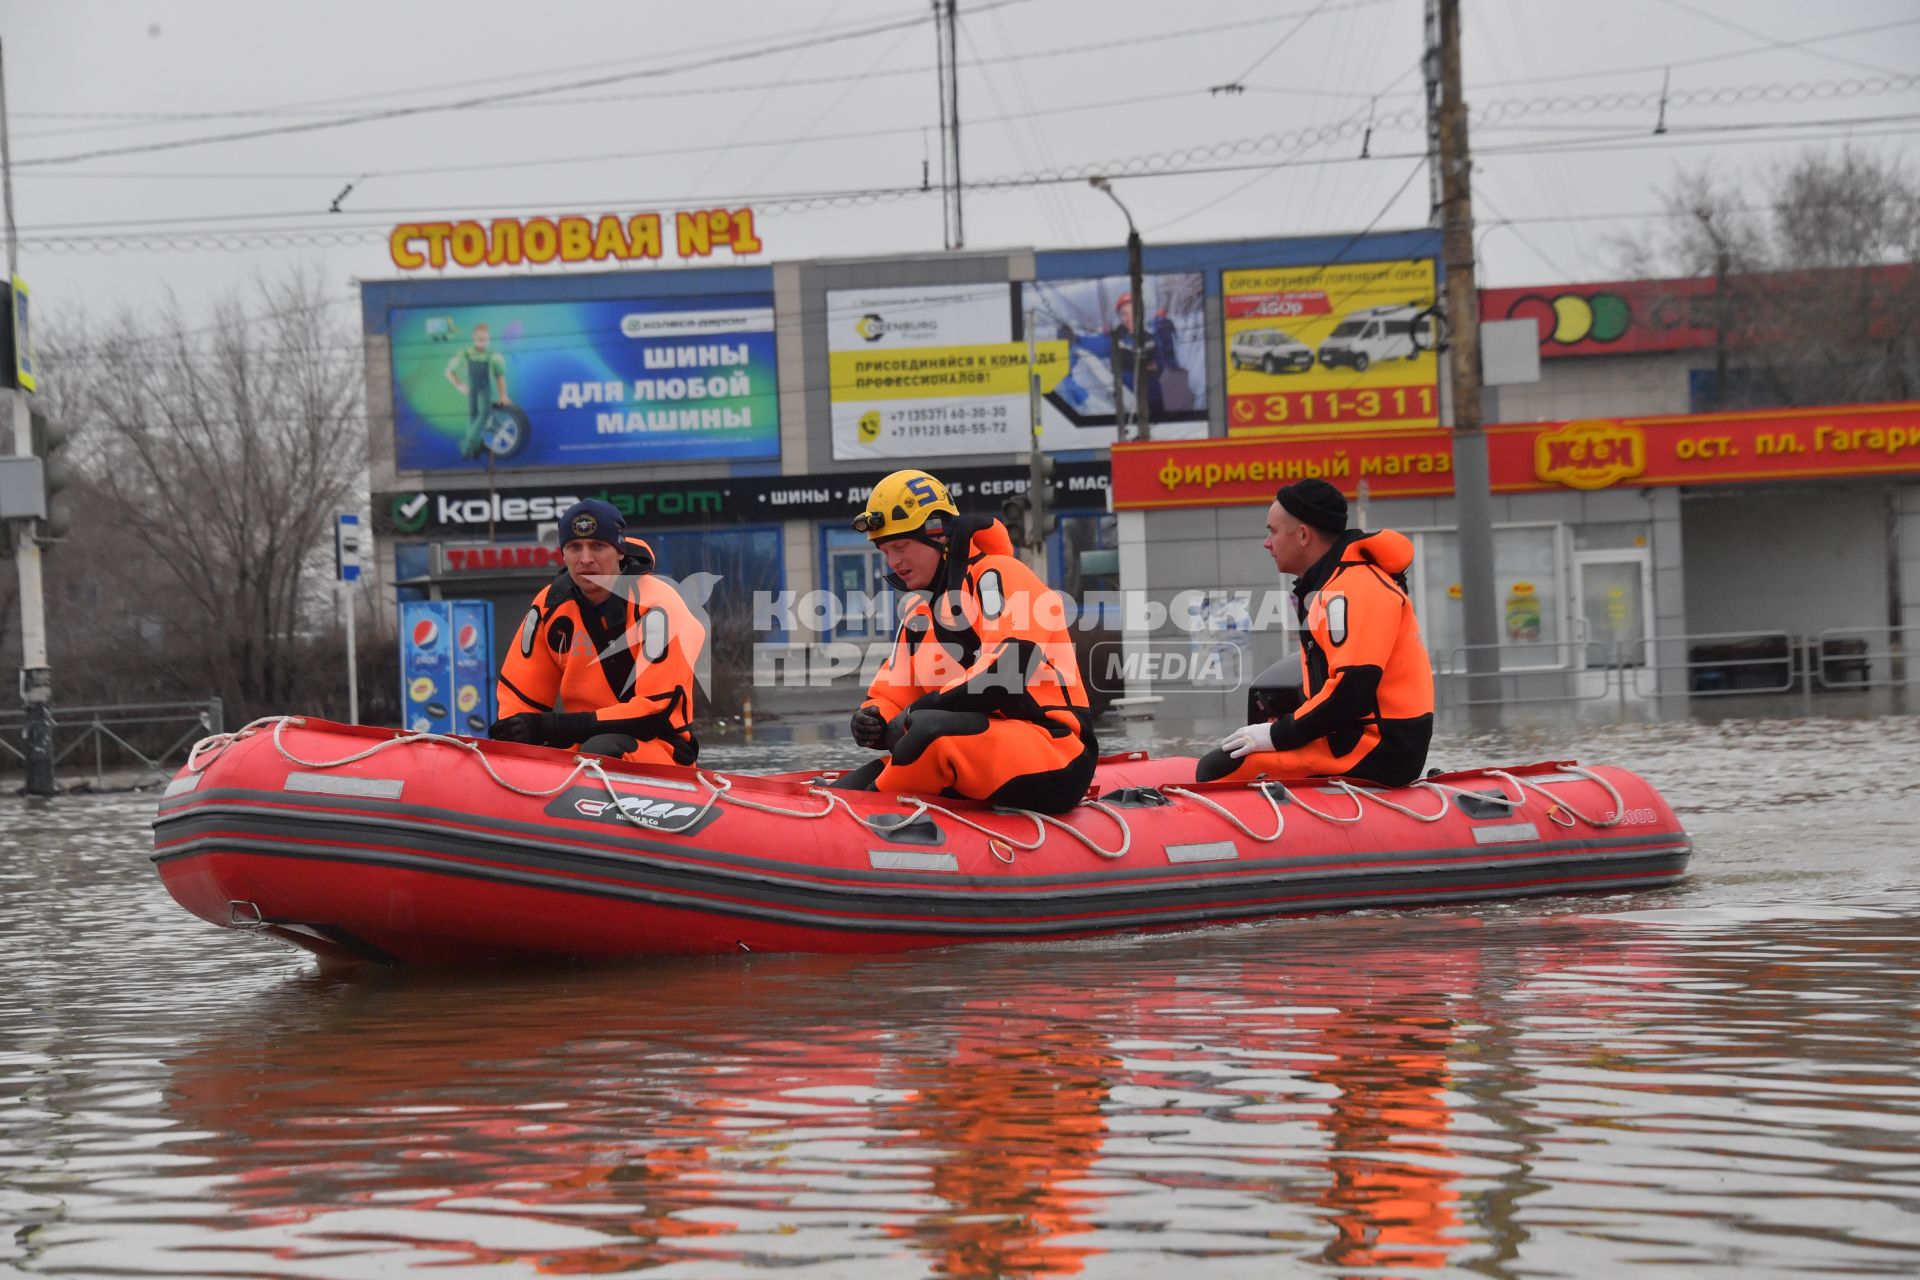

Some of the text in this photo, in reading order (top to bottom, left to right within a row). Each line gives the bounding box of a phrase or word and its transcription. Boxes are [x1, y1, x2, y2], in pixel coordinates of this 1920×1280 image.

[390, 208, 761, 270] СТОЛОВАЯ №1
[643, 344, 749, 370] ШИНЫ
[855, 352, 1057, 373] ПРИСОЕДИНЯЙСЯ К КОМАДЕ
[557, 370, 751, 410] ДЛЯ ЛЮБОЙ
[856, 372, 991, 389] ПРОФЕССИОНАЛОВ!
[1263, 388, 1432, 422] 311-311
[596, 407, 752, 435] МАШИНЫ
[1676, 436, 1739, 460] ост.
[1755, 434, 1805, 455] пл.
[1158, 451, 1349, 490] фирменный
[770, 488, 829, 505] ШИНЫ
